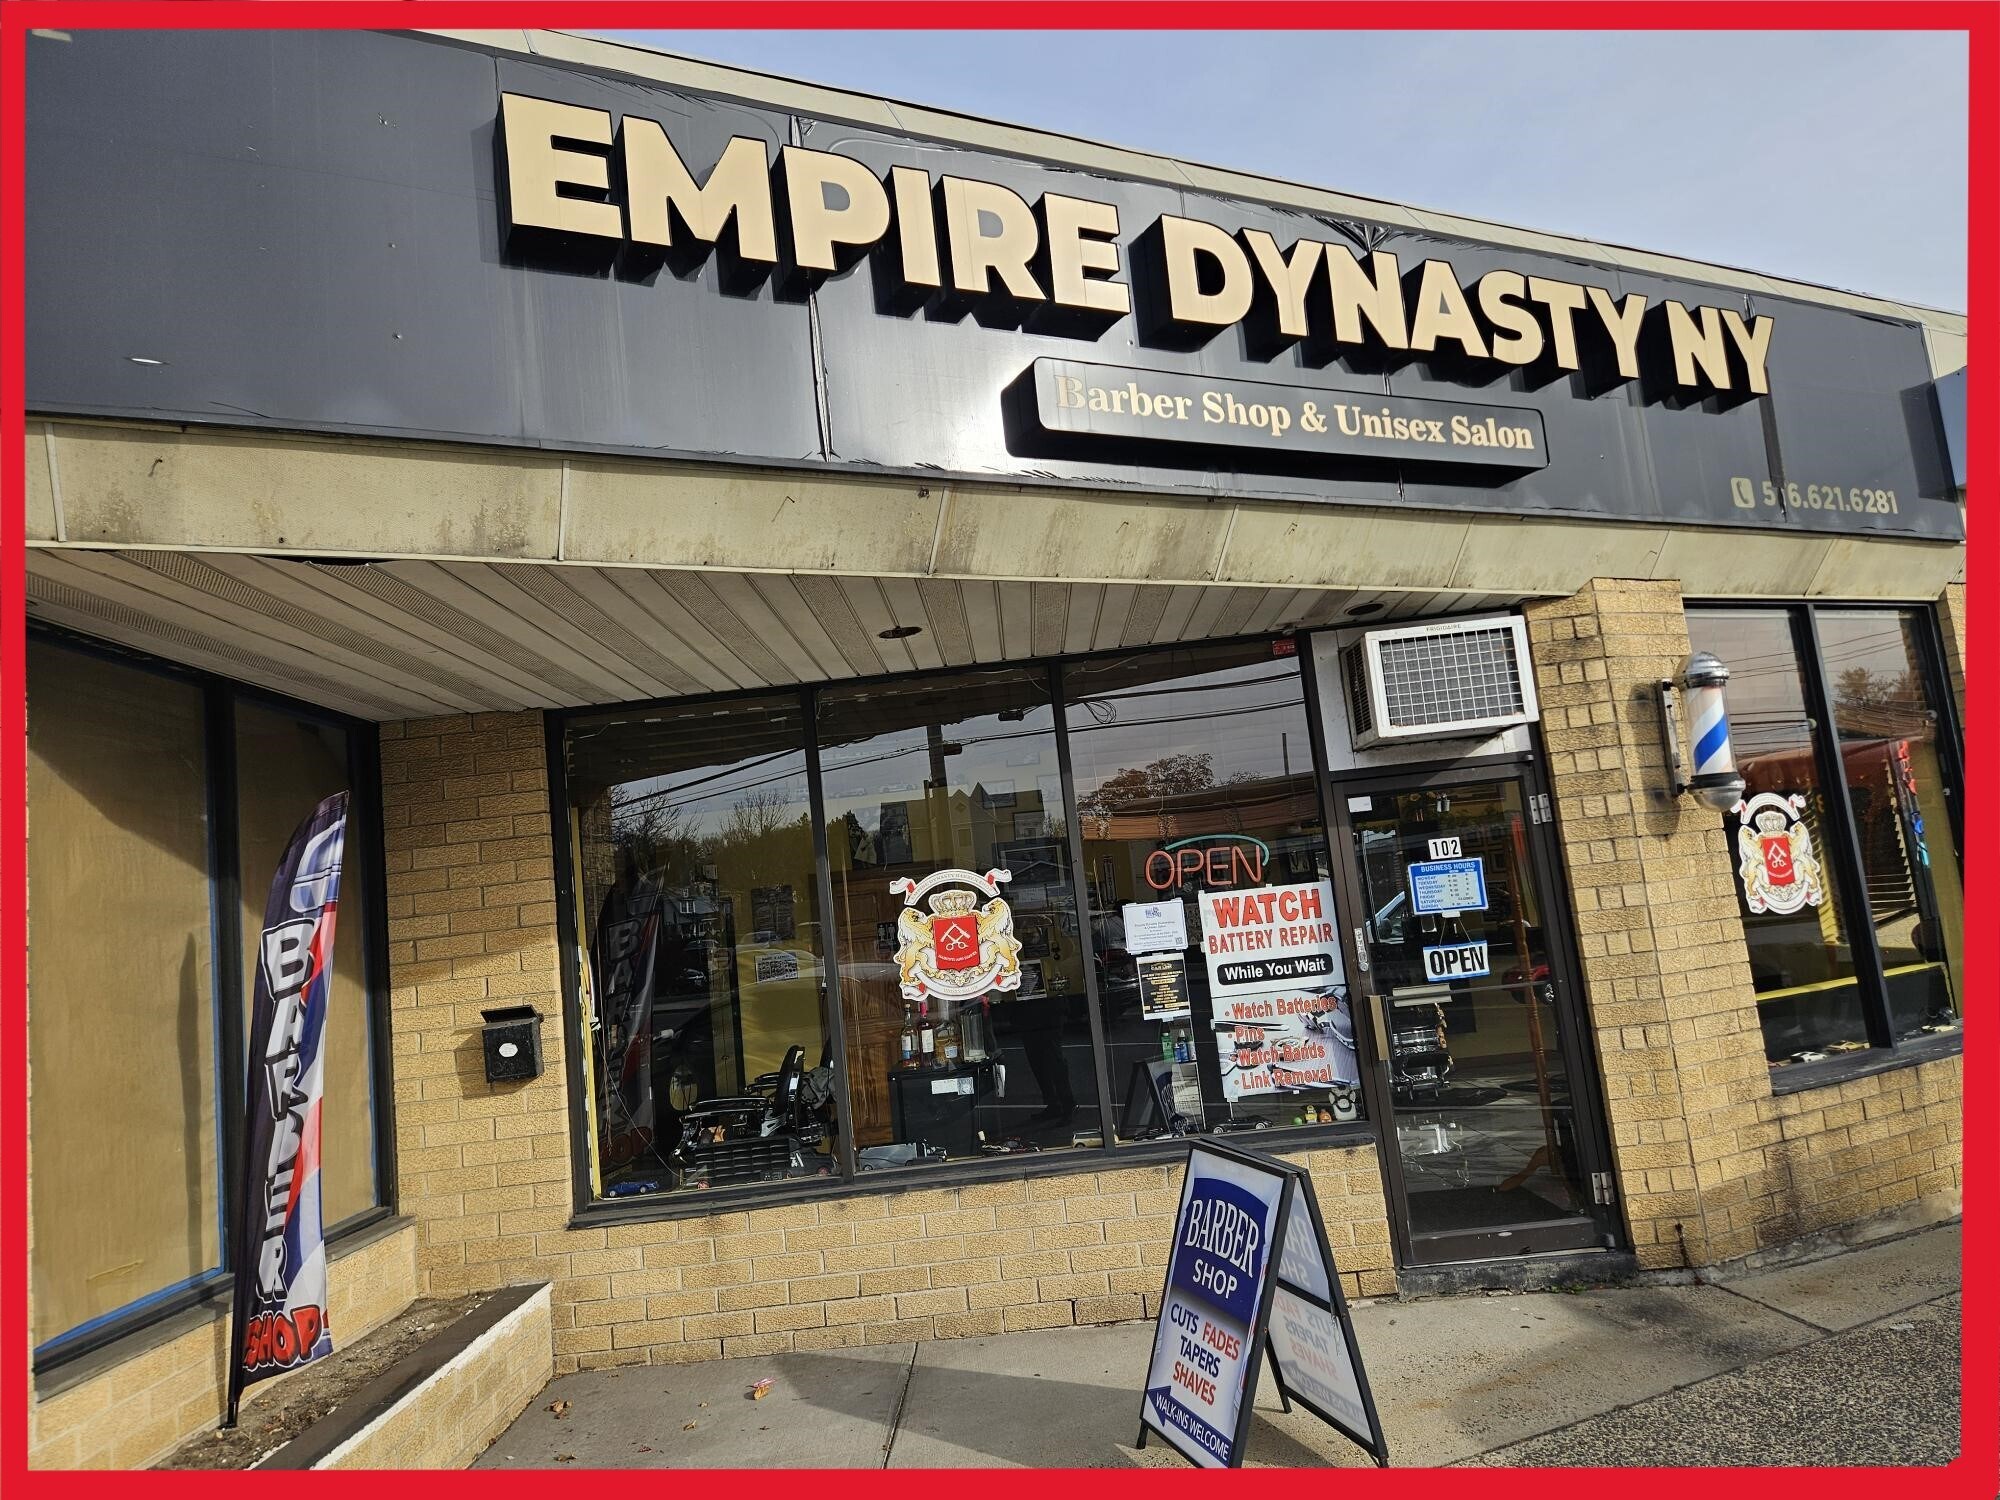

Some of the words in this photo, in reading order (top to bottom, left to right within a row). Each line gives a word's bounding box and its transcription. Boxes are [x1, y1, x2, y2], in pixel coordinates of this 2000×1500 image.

[502, 92, 1131, 315] EMPIRE
[1162, 214, 1648, 378] DYNASTY
[1666, 300, 1774, 395] NY
[1054, 374, 1192, 420] Barber
[1202, 391, 1291, 437] Shop
[1300, 401, 1327, 433] &
[1334, 404, 1446, 443] Unisex
[1450, 415, 1535, 450] Salon
[1762, 480, 1898, 514] 56.621.6281
[1426, 623, 1461, 632] FRIGIDAIRE
[1145, 845, 1262, 890] OPEN
[1420, 864, 1452, 872] BUSINESS
[1453, 862, 1476, 870] HOURS
[1432, 839, 1459, 857] 102
[1212, 888, 1323, 929] WATCH
[1208, 929, 1273, 955] BATTERY
[1279, 922, 1335, 947] REPAIR
[1224, 964, 1263, 980] While
[1266, 962, 1292, 976] You
[1295, 958, 1326, 973] Wait
[1429, 945, 1486, 976] OPEN
[1232, 1001, 1274, 1019] Watch
[1276, 995, 1338, 1016] Batteries
[1235, 1025, 1265, 1042] Pins
[1237, 1045, 1280, 1066] Watch
[1282, 1042, 1325, 1062] Bands
[1241, 1070, 1272, 1090] Link
[1272, 1064, 1333, 1087] Removal
[256, 918, 316, 1302] BARBER
[1185, 1199, 1260, 1279] BARBER
[1192, 1258, 1238, 1299] SHOP
[245, 1304, 323, 1367] SHOP
[1170, 1303, 1200, 1335] CUTS
[1202, 1321, 1241, 1361] FADES
[1179, 1335, 1221, 1378] TAPERS
[1173, 1360, 1217, 1406] SHAVES
[1155, 1392, 1189, 1429] WALK-INS
[1187, 1420, 1230, 1462] WELCOME
